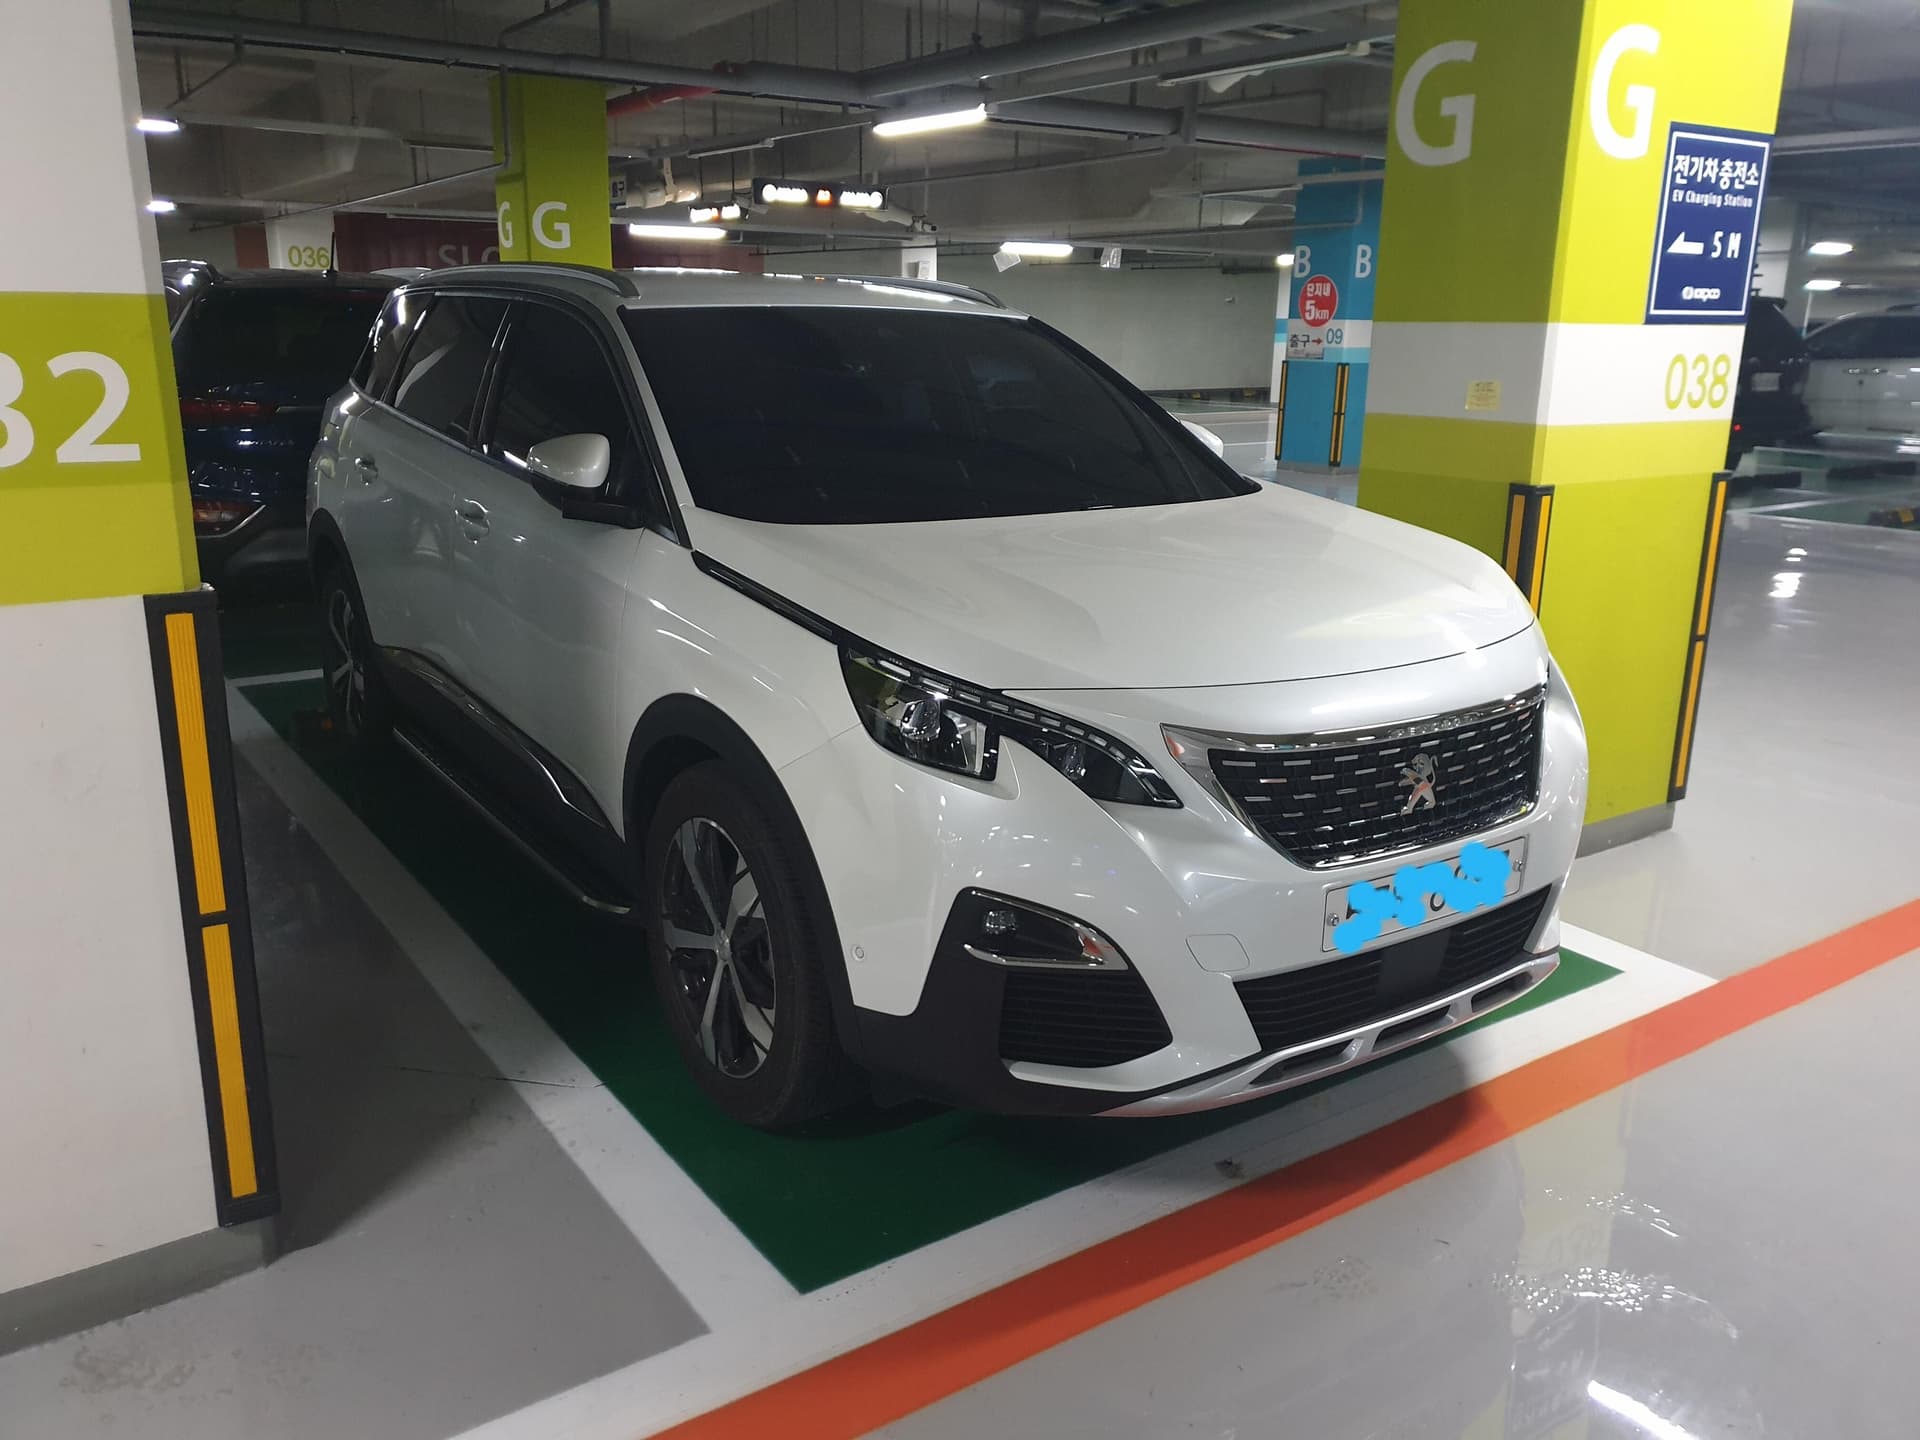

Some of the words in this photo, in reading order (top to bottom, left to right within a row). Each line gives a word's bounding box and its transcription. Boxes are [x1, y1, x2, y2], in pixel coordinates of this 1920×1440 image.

[1395, 40, 1478, 166] G
[1589, 23, 1661, 160] G
[1673, 154, 1760, 190] 전기차충전소
[1672, 189, 1685, 203] EV
[1686, 190, 1722, 208] Charging
[1723, 193, 1753, 208] Station
[499, 201, 513, 248] G
[532, 201, 571, 249] G
[287, 245, 330, 268] 036
[1294, 245, 1311, 278] B
[1355, 244, 1372, 278] B
[1711, 231, 1724, 258] 5
[1326, 328, 1343, 344] 09
[1664, 353, 1731, 409] 038
